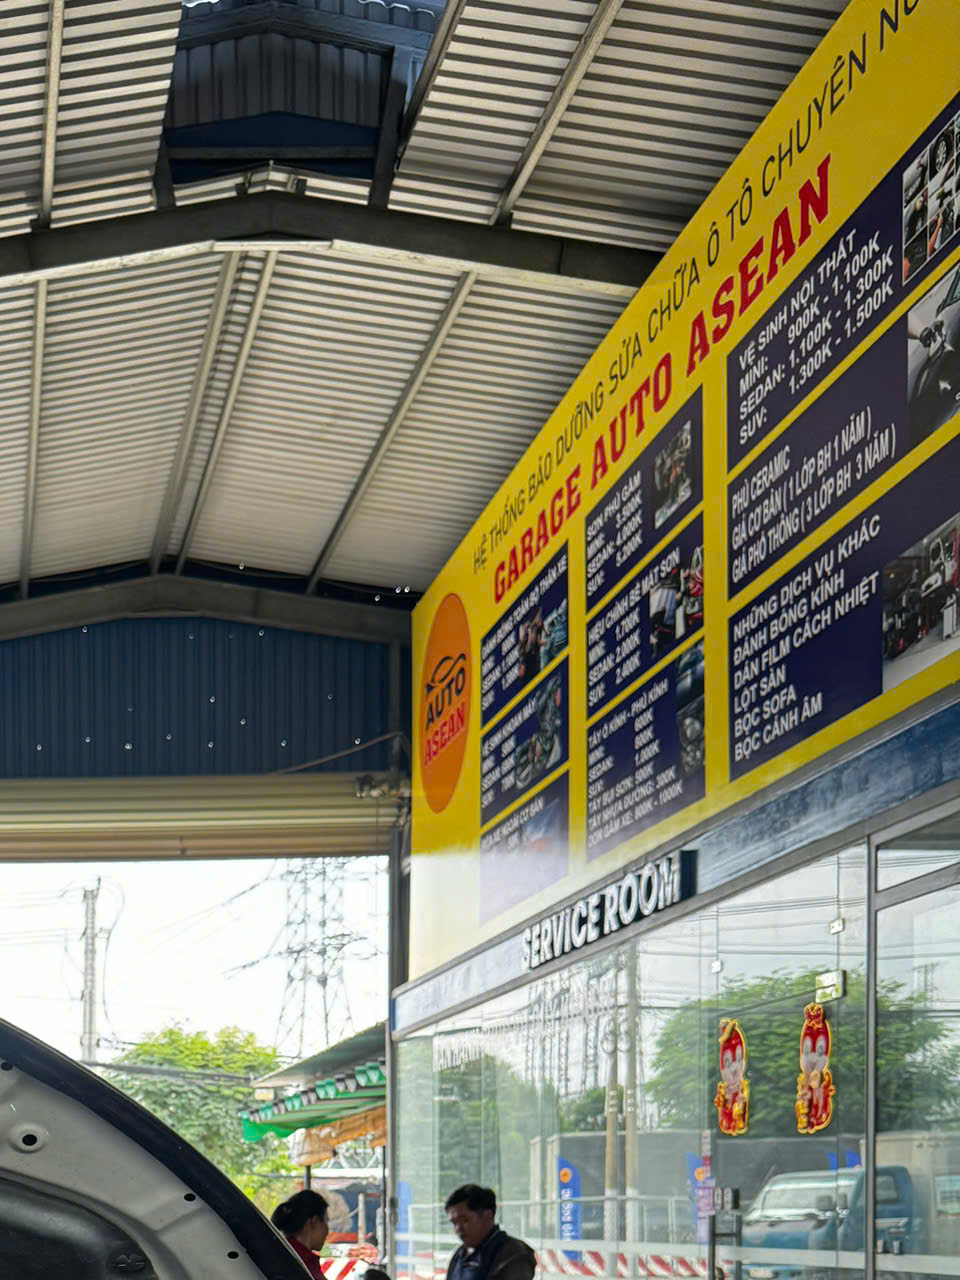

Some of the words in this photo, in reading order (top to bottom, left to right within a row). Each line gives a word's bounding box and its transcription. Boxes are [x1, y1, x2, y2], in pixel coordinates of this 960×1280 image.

[473, 533, 488, 575] HỆ
[490, 488, 525, 552] THỐNG
[528, 451, 552, 503] BẢO
[555, 381, 604, 466] DƯỠNG
[609, 332, 642, 395] SỬA
[647, 256, 700, 343] CHỮA
[707, 221, 720, 268] Ô
[726, 177, 753, 242] TÔ
[761, 32, 867, 198] CHUYÊN
[739, 339, 756, 371] VỆ
[758, 305, 787, 351] SINH
[791, 276, 815, 317] NỘI
[817, 229, 857, 285] THẤT
[740, 355, 768, 397] MINI:
[788, 296, 820, 345] 900K
[832, 230, 880, 296] 1.100K
[740, 364, 785, 420] SEDAN:
[789, 310, 832, 368] 1.100K
[844, 244, 894, 311] 1.300K
[740, 405, 767, 445] SUV:
[789, 338, 832, 395] 1.300K
[844, 275, 894, 339] 1.500K
[493, 463, 581, 605] GARAGE
[590, 352, 672, 491] AUTO
[686, 152, 831, 379] ASEAN
[732, 512, 747, 550] GIÁ
[748, 505, 762, 536] CƠ
[762, 487, 781, 525] BẢN
[796, 456, 816, 496] LỚP
[817, 441, 832, 477] BH
[834, 435, 839, 461] 1
[841, 412, 865, 456] NĂM
[732, 547, 747, 583] GIÁ
[767, 507, 799, 554] THÔNG
[814, 477, 834, 517] LỚP
[837, 462, 851, 497] BH
[855, 453, 862, 481] 3
[865, 428, 889, 473] NĂM
[751, 445, 790, 501] CERAMIC
[733, 626, 767, 666] ĐÁNH
[770, 598, 807, 640] BÓNG
[811, 568, 844, 610] KÍNH
[734, 595, 777, 642] NHỮNG
[780, 567, 812, 607] DỊCH
[815, 549, 834, 579] VỤ
[838, 515, 881, 563] KHÁC
[734, 657, 759, 691] DÁN
[761, 635, 790, 671] FILM
[793, 605, 831, 648] CÁCH
[835, 570, 879, 620] NHIỆT
[424, 702, 466, 768] ASEAN
[425, 666, 465, 731] AUTO
[734, 706, 760, 738] BỌC
[762, 684, 797, 719] SOFA
[735, 731, 761, 761] BỌC
[763, 706, 798, 744] CÁNH
[801, 692, 823, 722] ÂM
[760, 664, 786, 696] SÀN
[521, 893, 601, 971] SERVICE
[603, 850, 681, 936] ROOM
